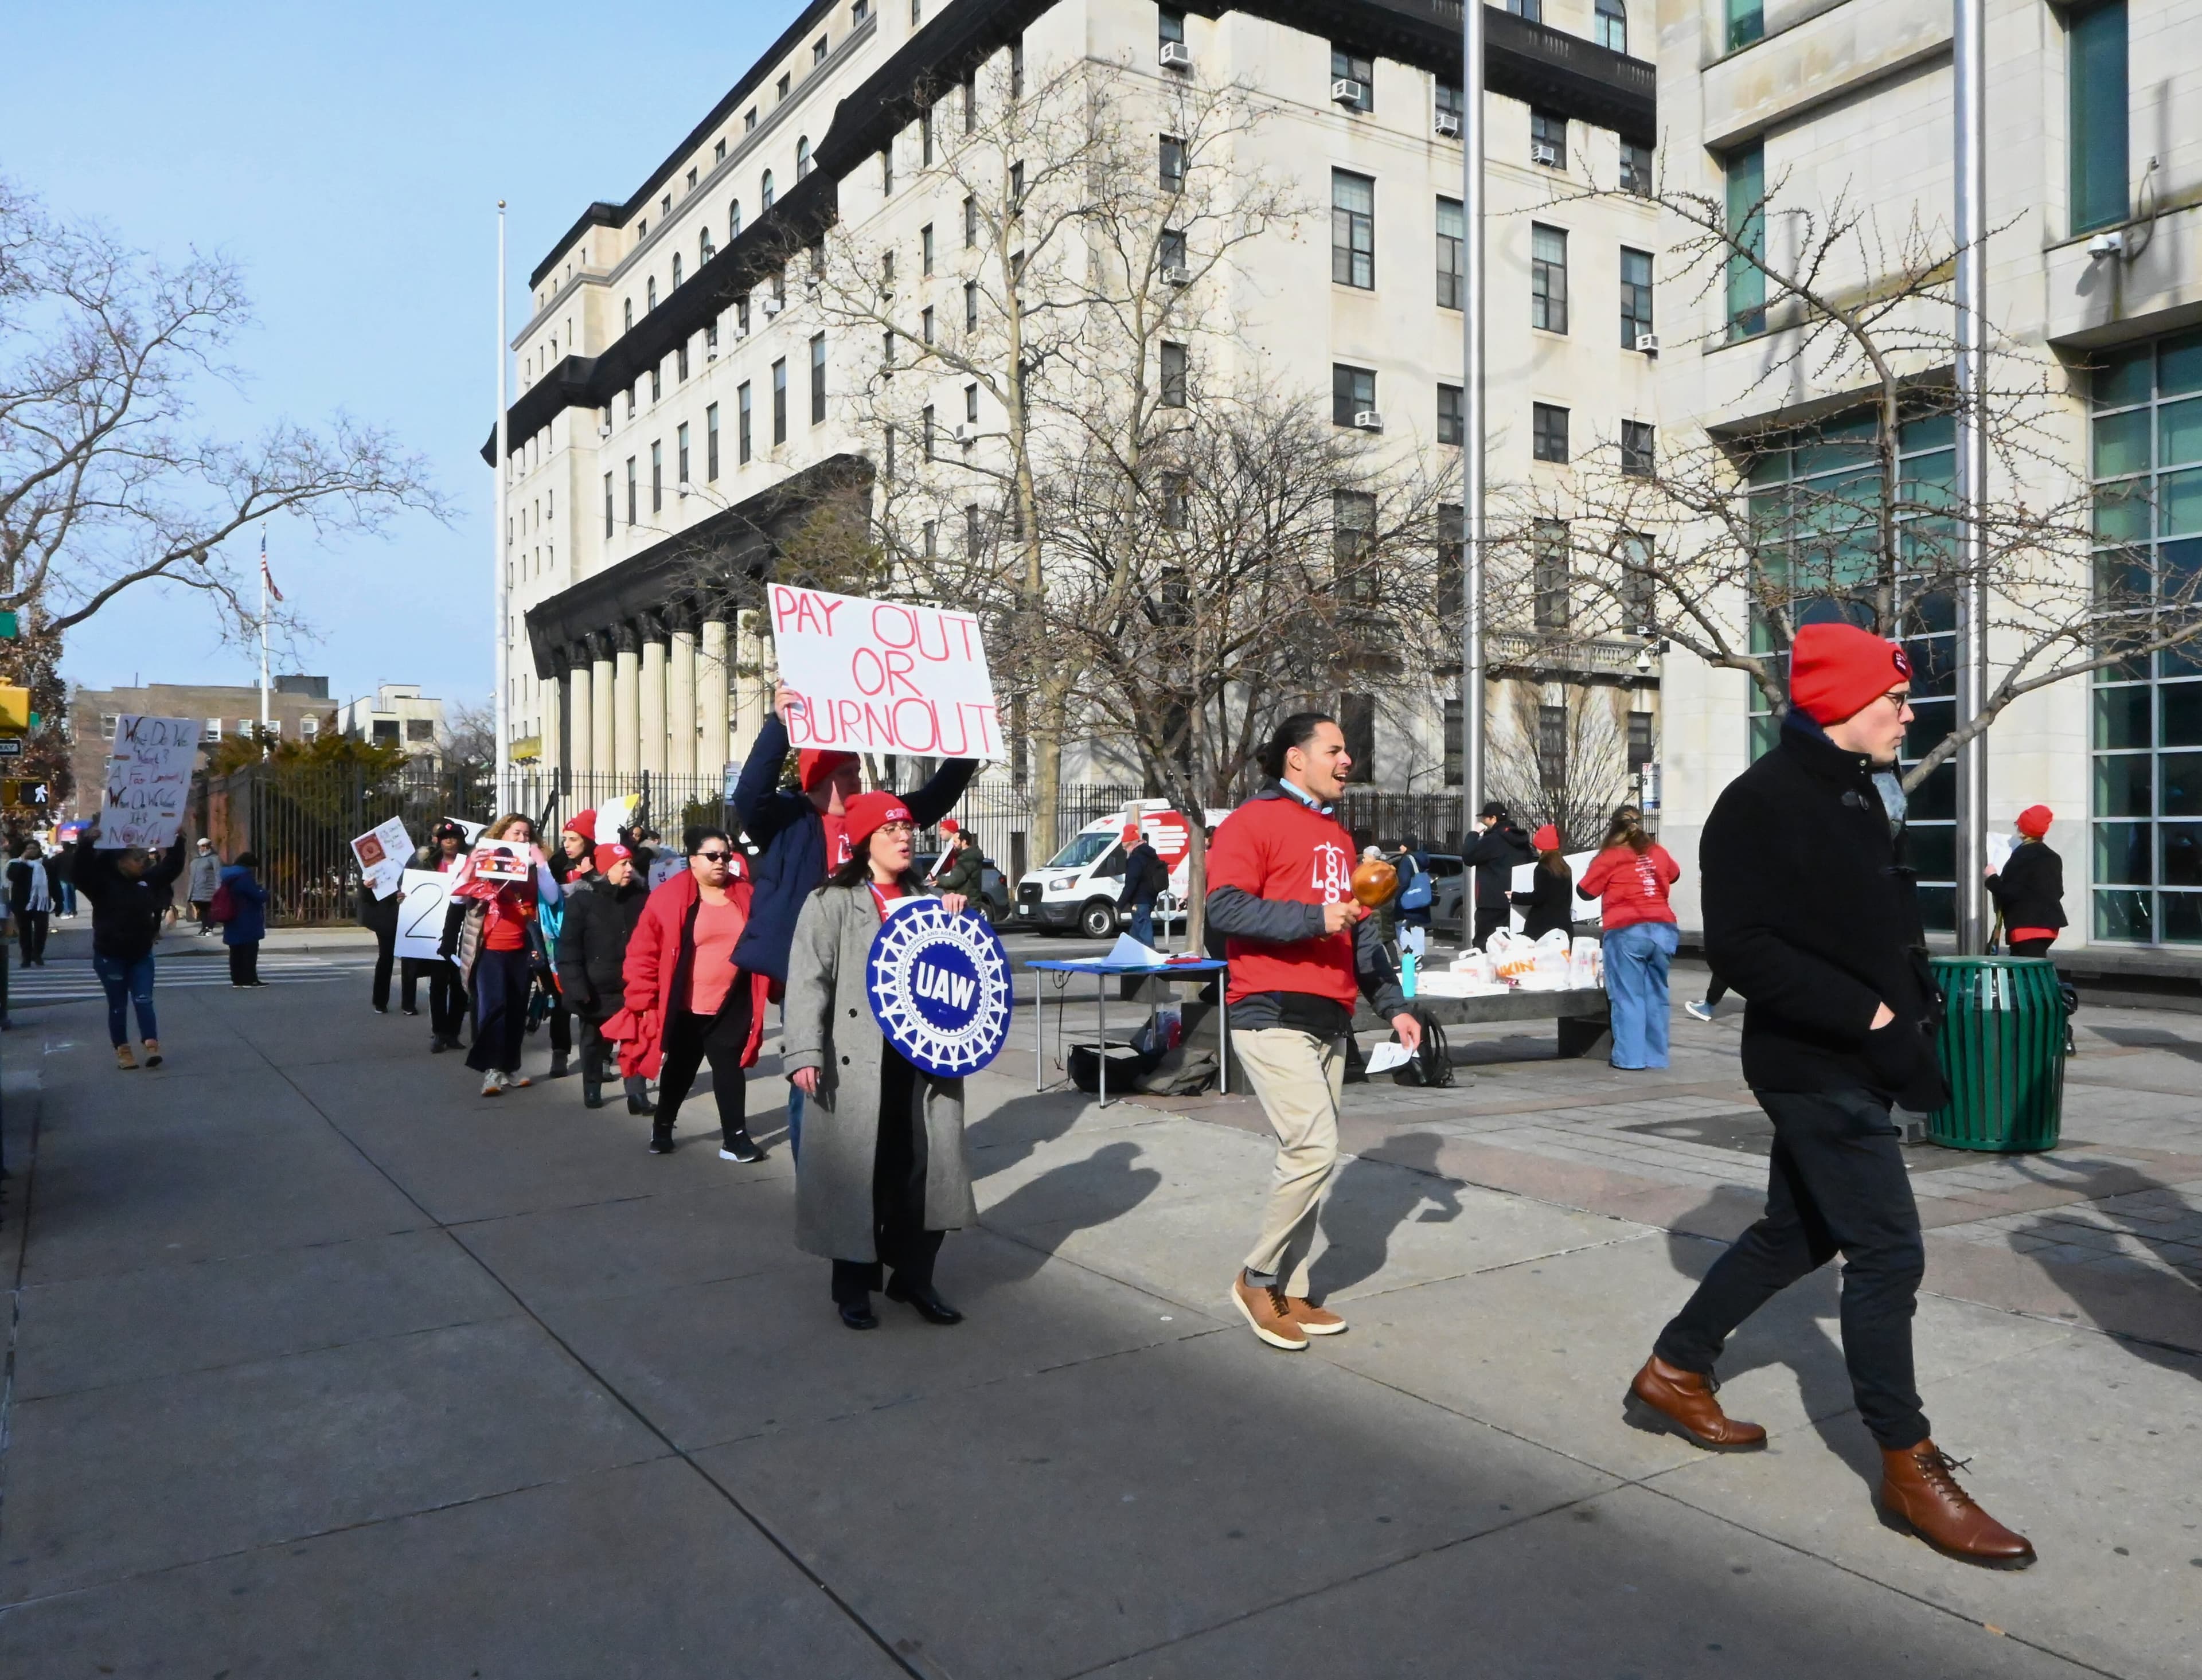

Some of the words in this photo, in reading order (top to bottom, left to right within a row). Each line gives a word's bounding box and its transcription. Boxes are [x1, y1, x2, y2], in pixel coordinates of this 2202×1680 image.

[775, 587, 844, 636] PAY
[872, 604, 977, 662] OUT
[852, 647, 924, 697] OR
[787, 691, 995, 756] BURNOUT
[903, 935, 925, 959] AEROSPACE
[898, 962, 906, 1003] AUTOMOBILE
[916, 961, 976, 1011] UAW
[904, 1005, 919, 1025] UNITED
